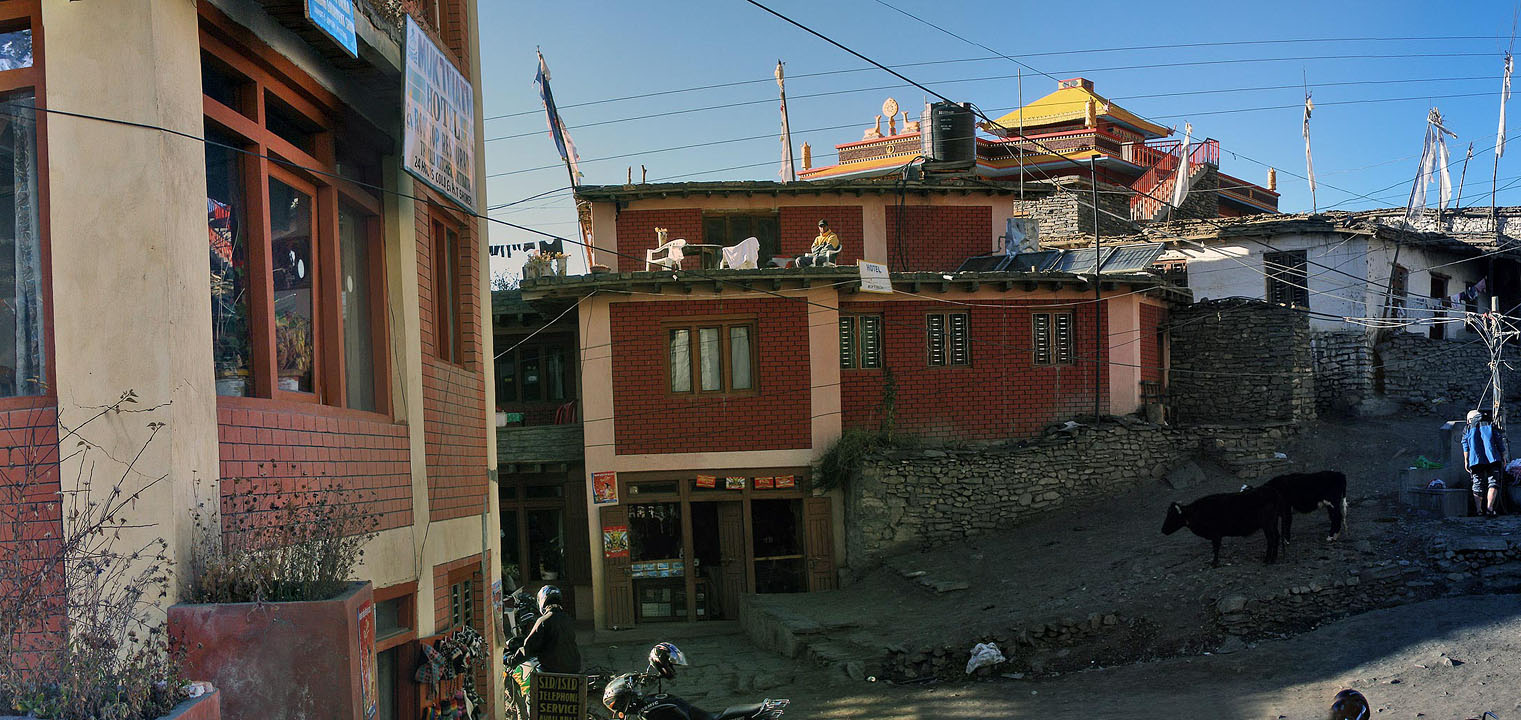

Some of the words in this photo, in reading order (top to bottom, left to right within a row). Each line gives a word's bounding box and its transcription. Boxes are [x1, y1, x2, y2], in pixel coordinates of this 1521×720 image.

[426, 83, 460, 140] HOTEL
[866, 264, 882, 273] HOTEL
[539, 676, 578, 690] STD/ISD
[539, 690, 578, 703] TELEPHONE
[540, 703, 578, 714] SERVICE
